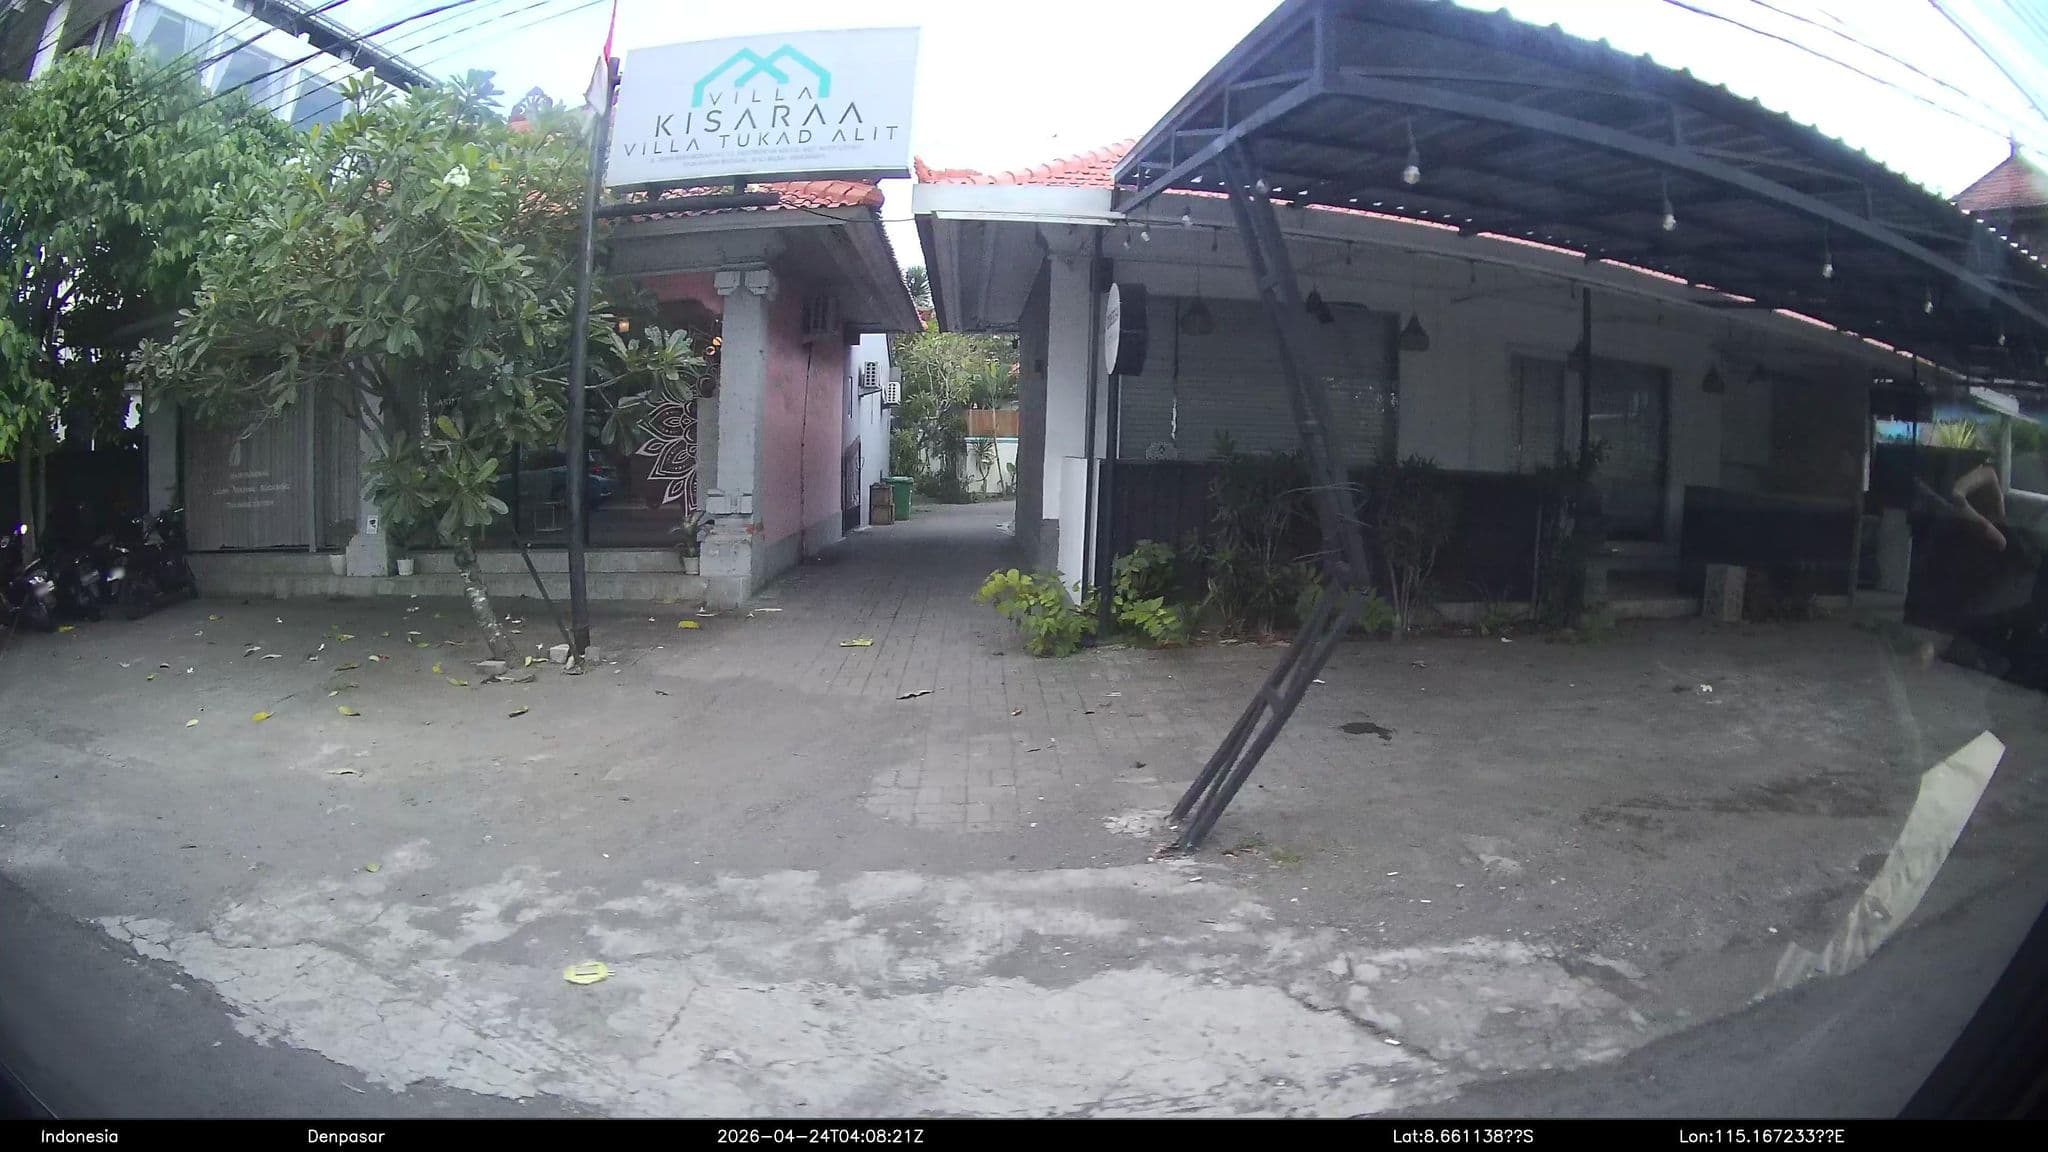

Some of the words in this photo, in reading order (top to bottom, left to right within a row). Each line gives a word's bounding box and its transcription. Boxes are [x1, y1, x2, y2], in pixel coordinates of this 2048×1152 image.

[709, 86, 813, 105] VILLA
[654, 101, 864, 138] KISARAA
[623, 138, 700, 157] VILLA
[718, 128, 813, 149] TUKAD
[831, 125, 899, 143] ALIT
